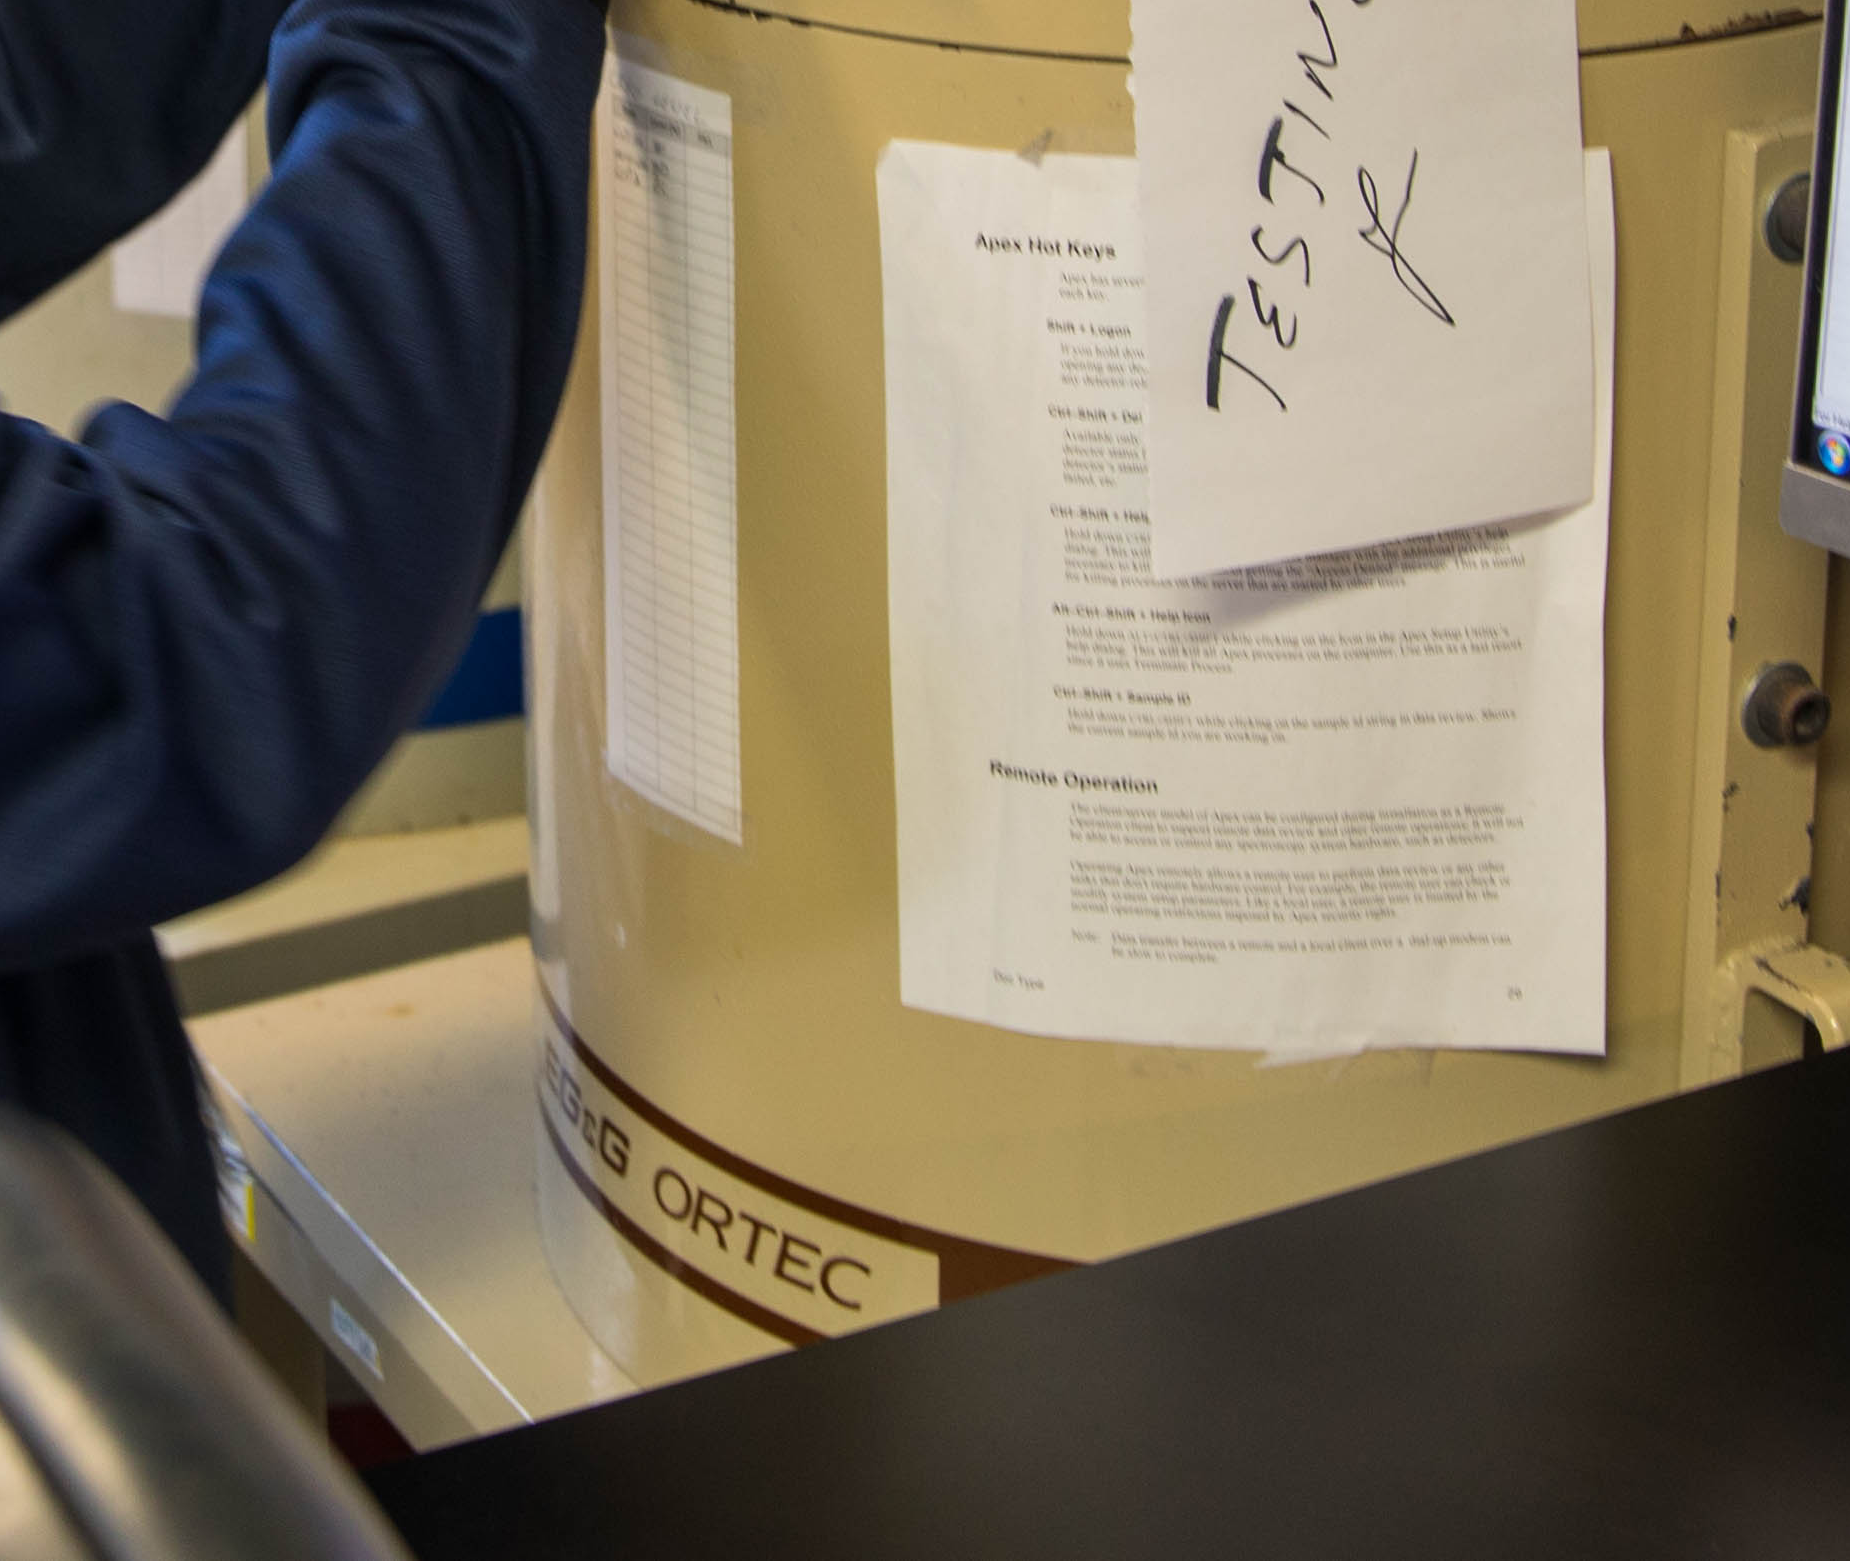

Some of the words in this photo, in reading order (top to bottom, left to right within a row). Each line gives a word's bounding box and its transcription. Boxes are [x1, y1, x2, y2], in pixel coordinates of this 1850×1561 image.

[975, 232, 1022, 257] Apex
[1029, 236, 1062, 257] Hot
[1067, 238, 1117, 262] Keys
[1046, 318, 1075, 335] Shift
[1089, 323, 1132, 340] Logon
[1150, 608, 1180, 626] Help
[1127, 689, 1174, 707] Sample
[989, 759, 1059, 788] Remote
[1064, 771, 1159, 795] Operation
[653, 1166, 872, 1312] ORTEC
